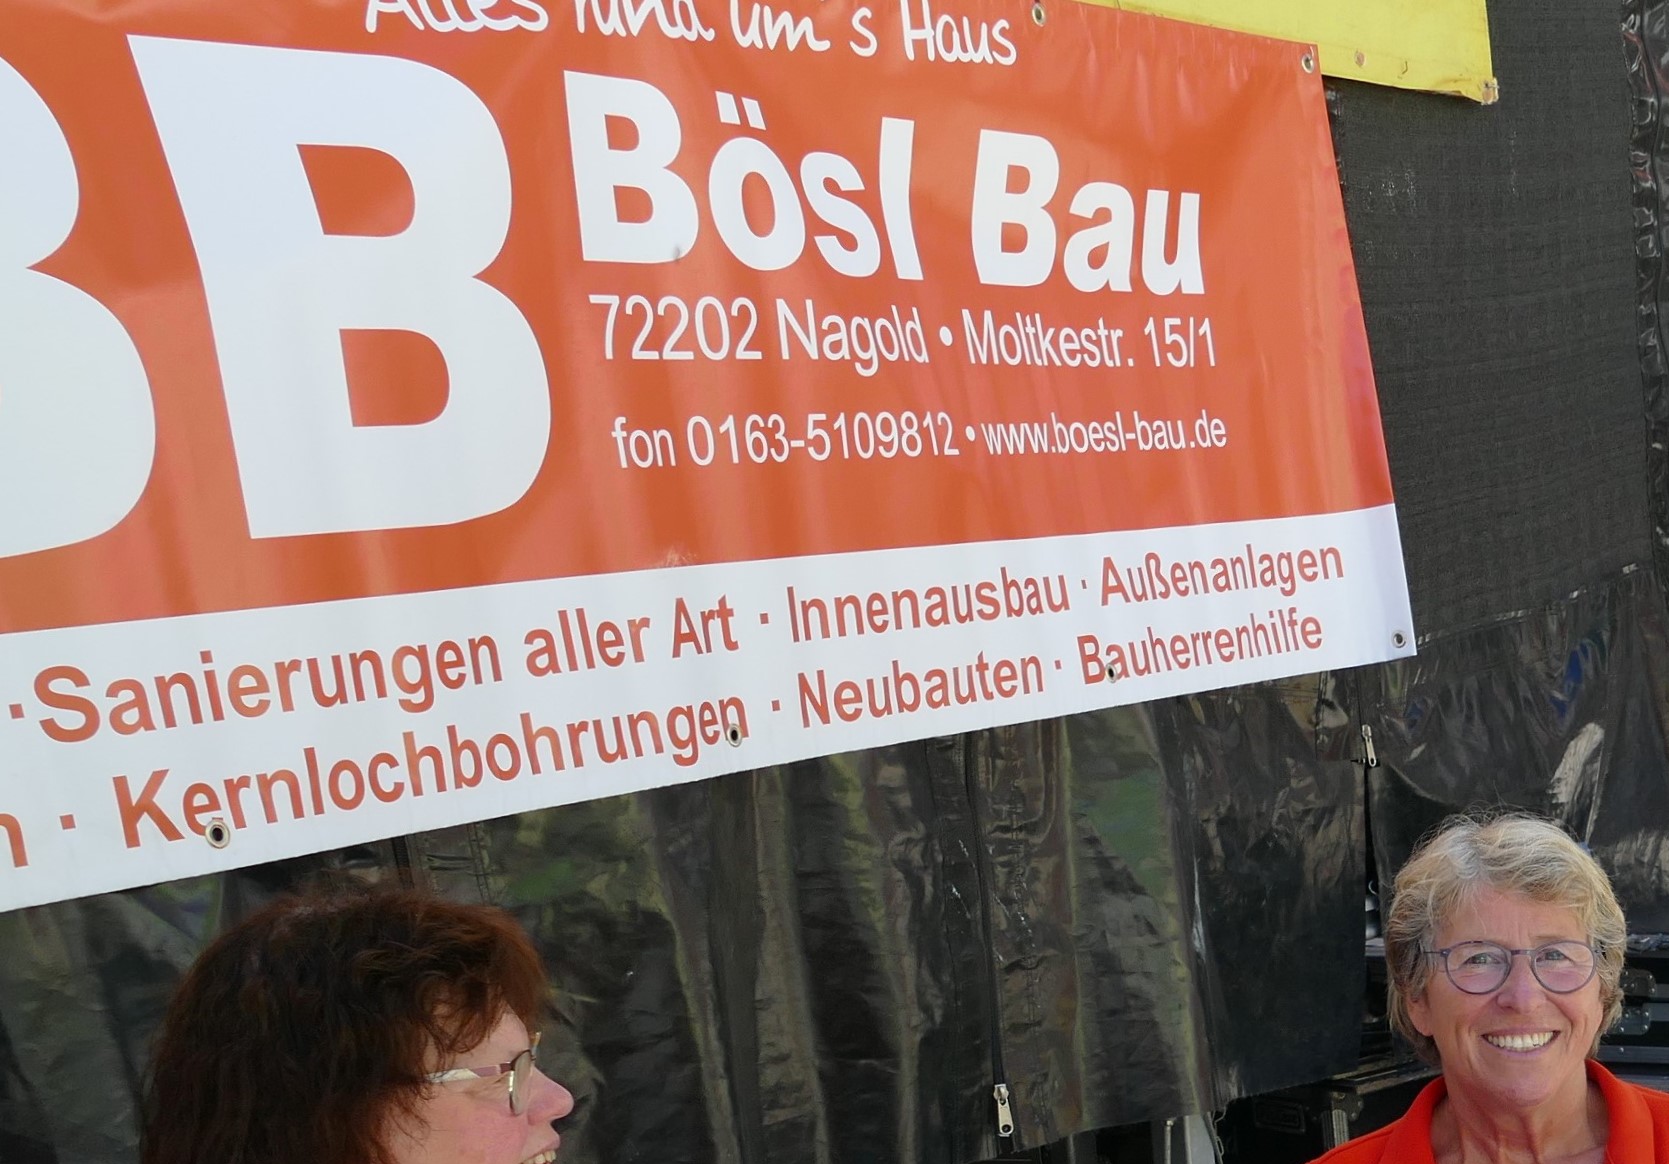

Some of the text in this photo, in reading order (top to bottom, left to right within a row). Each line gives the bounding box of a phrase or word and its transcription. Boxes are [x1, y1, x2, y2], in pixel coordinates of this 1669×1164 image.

[576, 0, 715, 42] rund
[899, 0, 1018, 66] Haus
[563, 70, 1206, 296] Bösl Bau
[588, 294, 1217, 379] 72202 Nagold Moltkestr. 15/1
[611, 408, 1228, 471] fon 0163-5109812 www.boesl-bau.de
[32, 543, 1345, 744] Sanierungen aller Art Innenausbau Außenanlagen
[111, 694, 751, 850] Kernlochbohrungen
[796, 650, 1045, 729] Neubauten
[1076, 607, 1324, 686] Bauherrenhilfe
